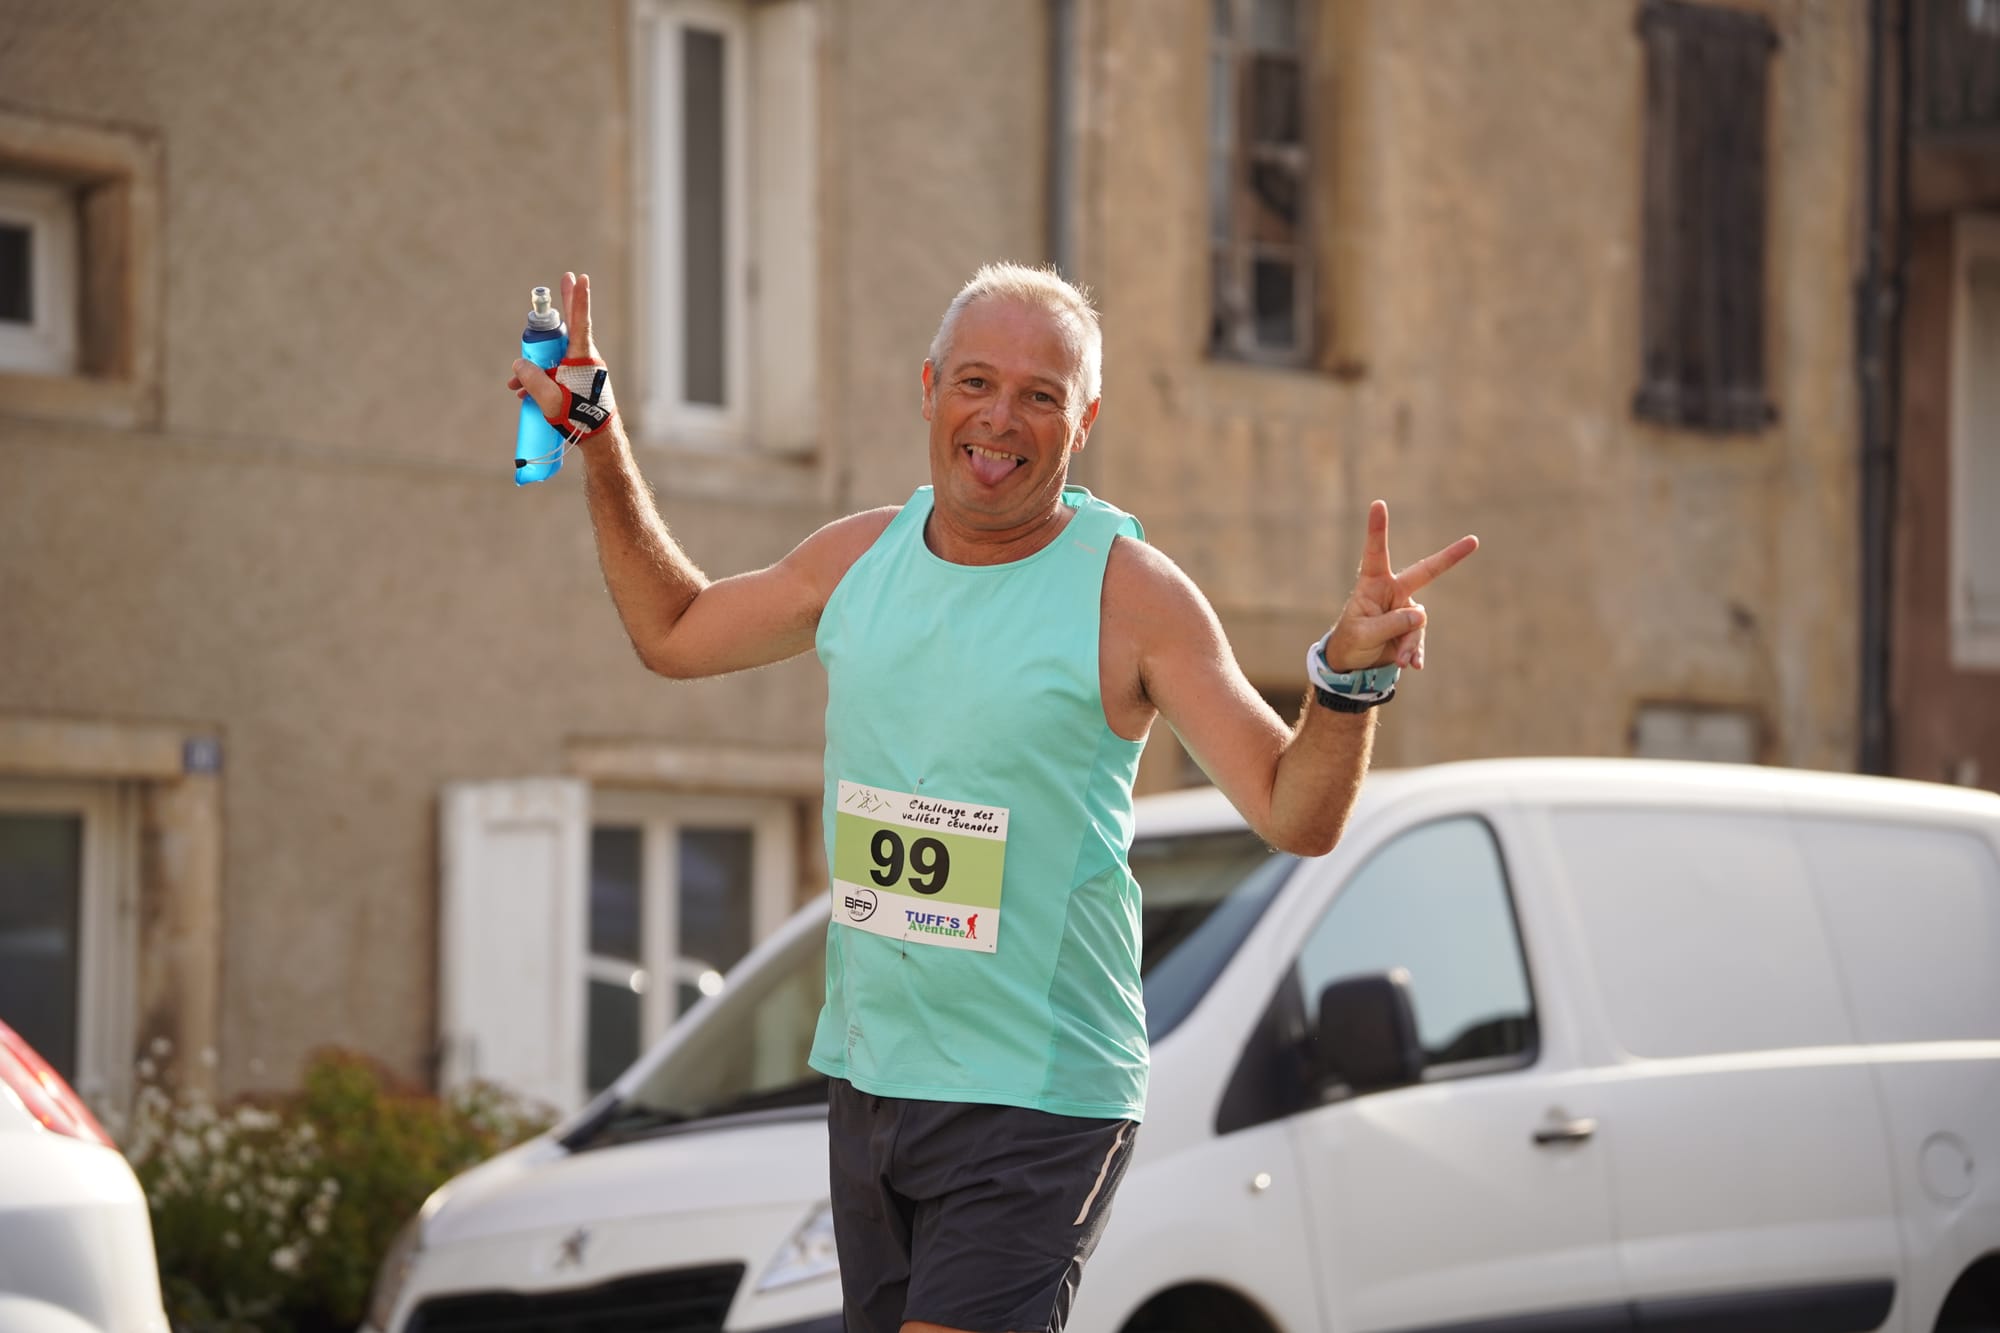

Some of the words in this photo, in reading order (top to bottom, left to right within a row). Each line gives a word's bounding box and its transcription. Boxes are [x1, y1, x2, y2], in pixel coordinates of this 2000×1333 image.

[909, 799, 966, 819] Challenge
[973, 810, 994, 821] des
[902, 812, 940, 825] vallées
[947, 818, 999, 834] cévenoles
[870, 829, 950, 895] 99
[844, 896, 873, 912] BFP
[904, 910, 960, 929] TUFF'S
[908, 920, 966, 938] Aventure
